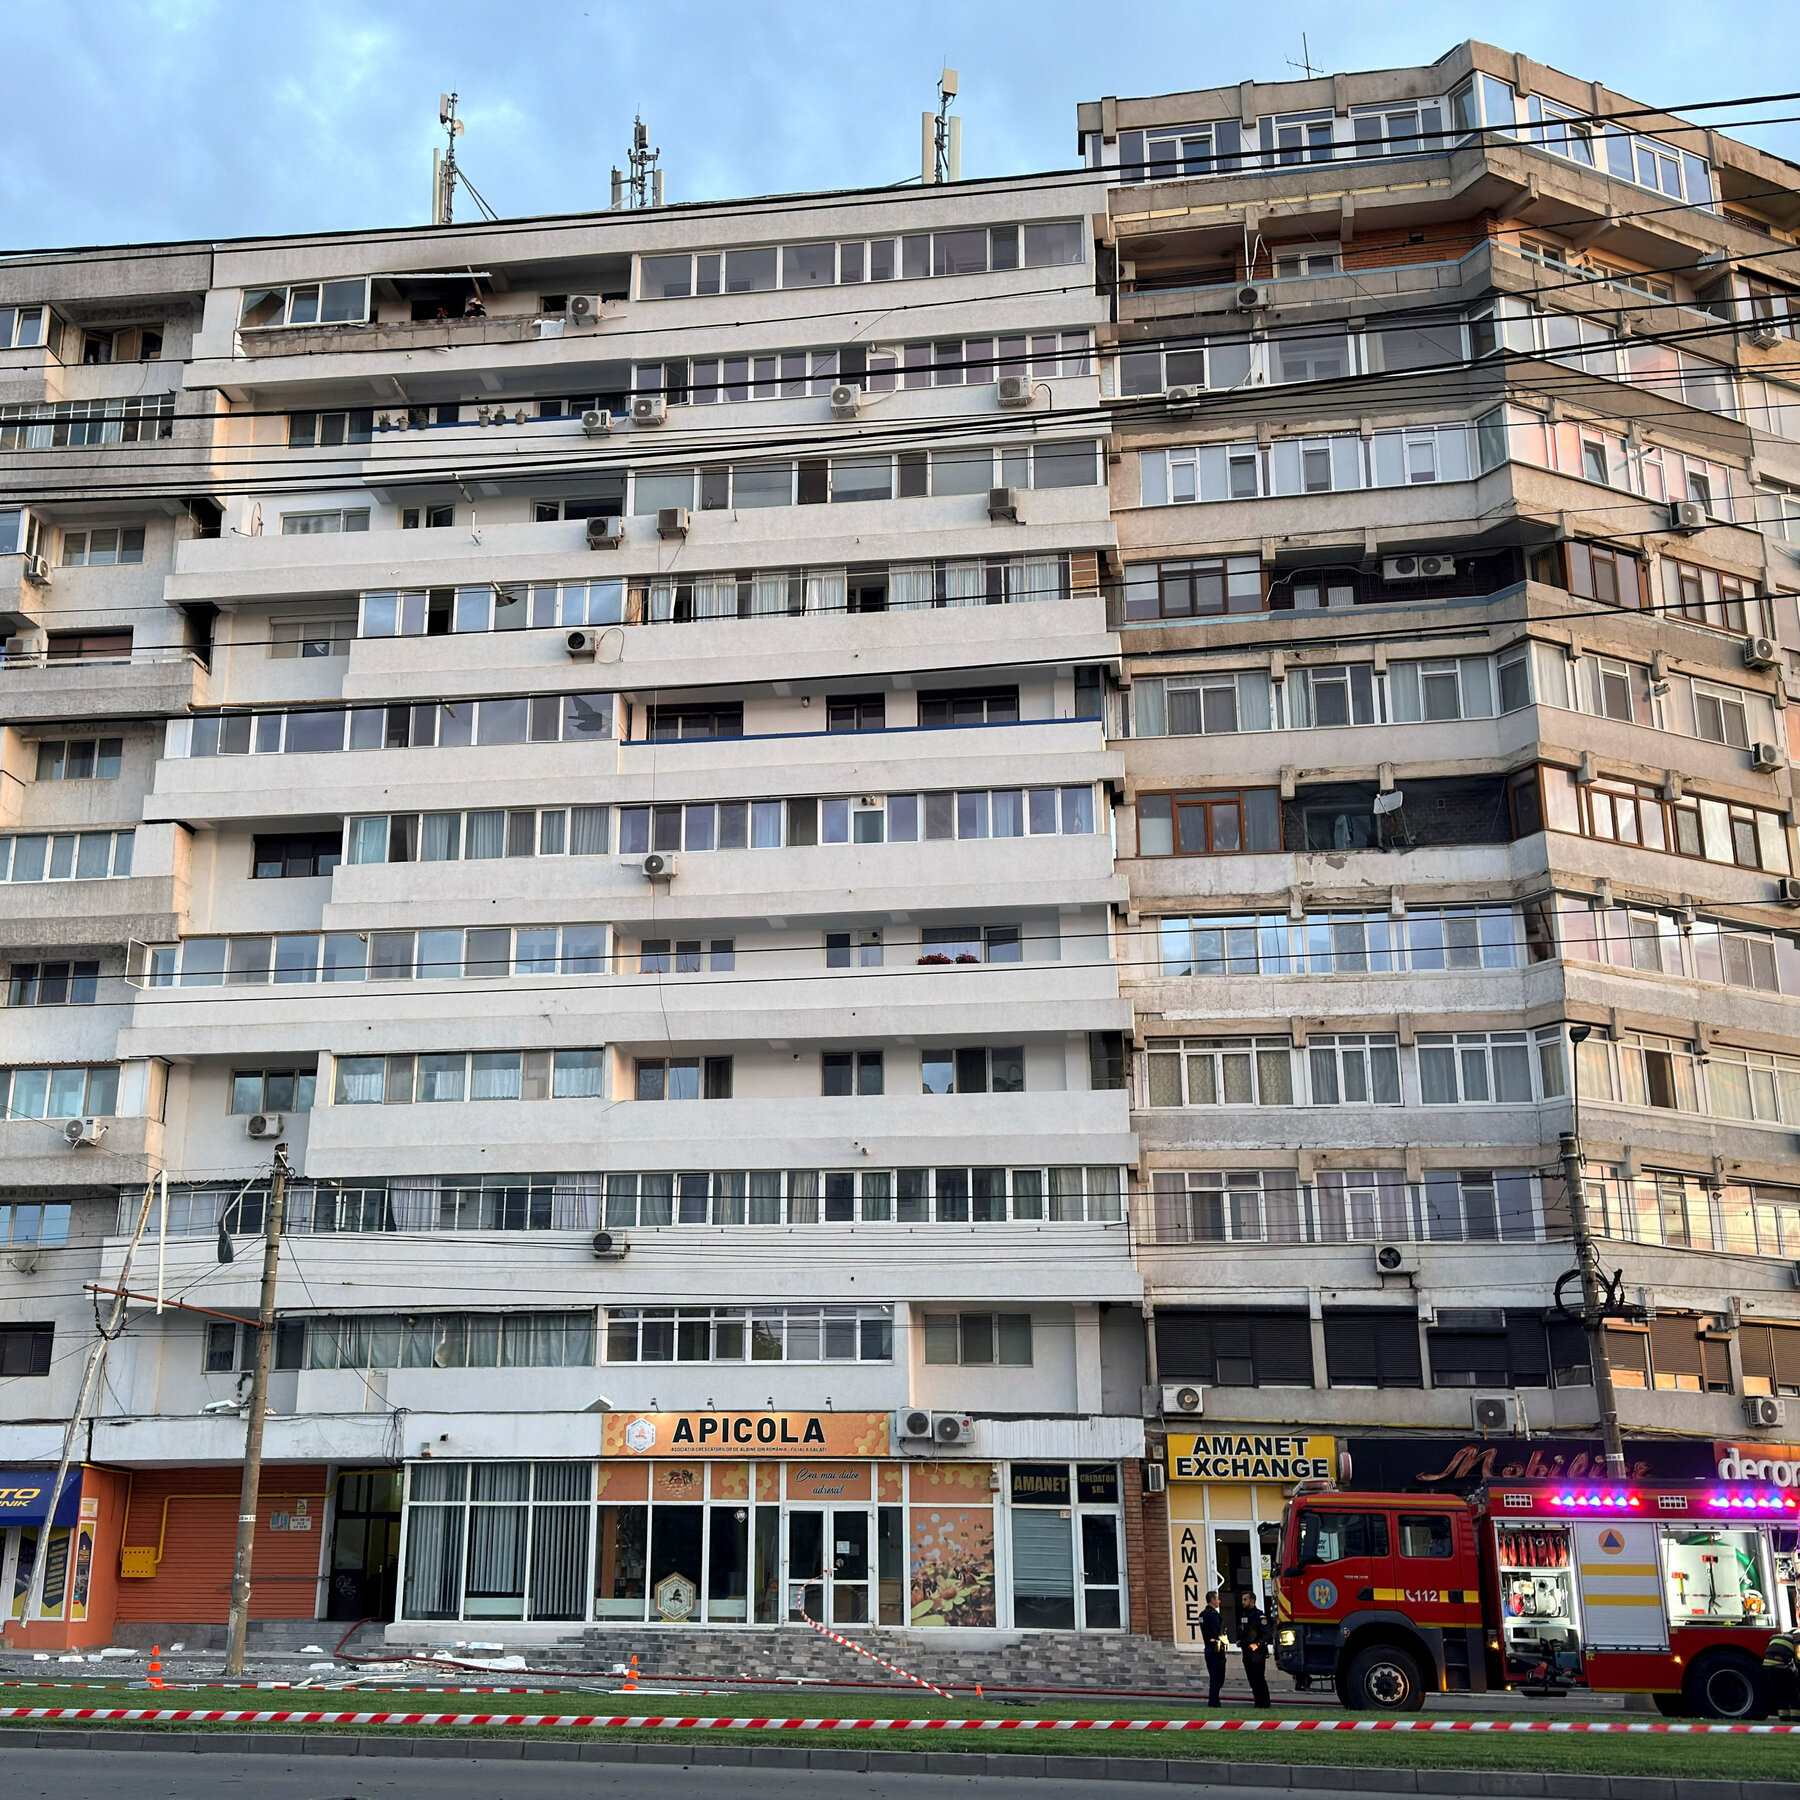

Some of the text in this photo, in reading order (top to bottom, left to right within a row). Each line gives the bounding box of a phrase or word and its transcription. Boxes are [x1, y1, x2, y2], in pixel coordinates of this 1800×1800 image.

[671, 1417, 826, 1444] APICOLA
[1192, 1436, 1309, 1456] AMANET
[1176, 1457, 1329, 1478] EXCHANGE
[1416, 1443, 1652, 1481] Mobilir
[796, 1467, 861, 1483] Cea mai dulce
[1013, 1475, 1068, 1493] AMANET
[1091, 1485, 1105, 1494] SRL
[1181, 1527, 1200, 1640] AMANET
[1414, 1589, 1438, 1602] 112
